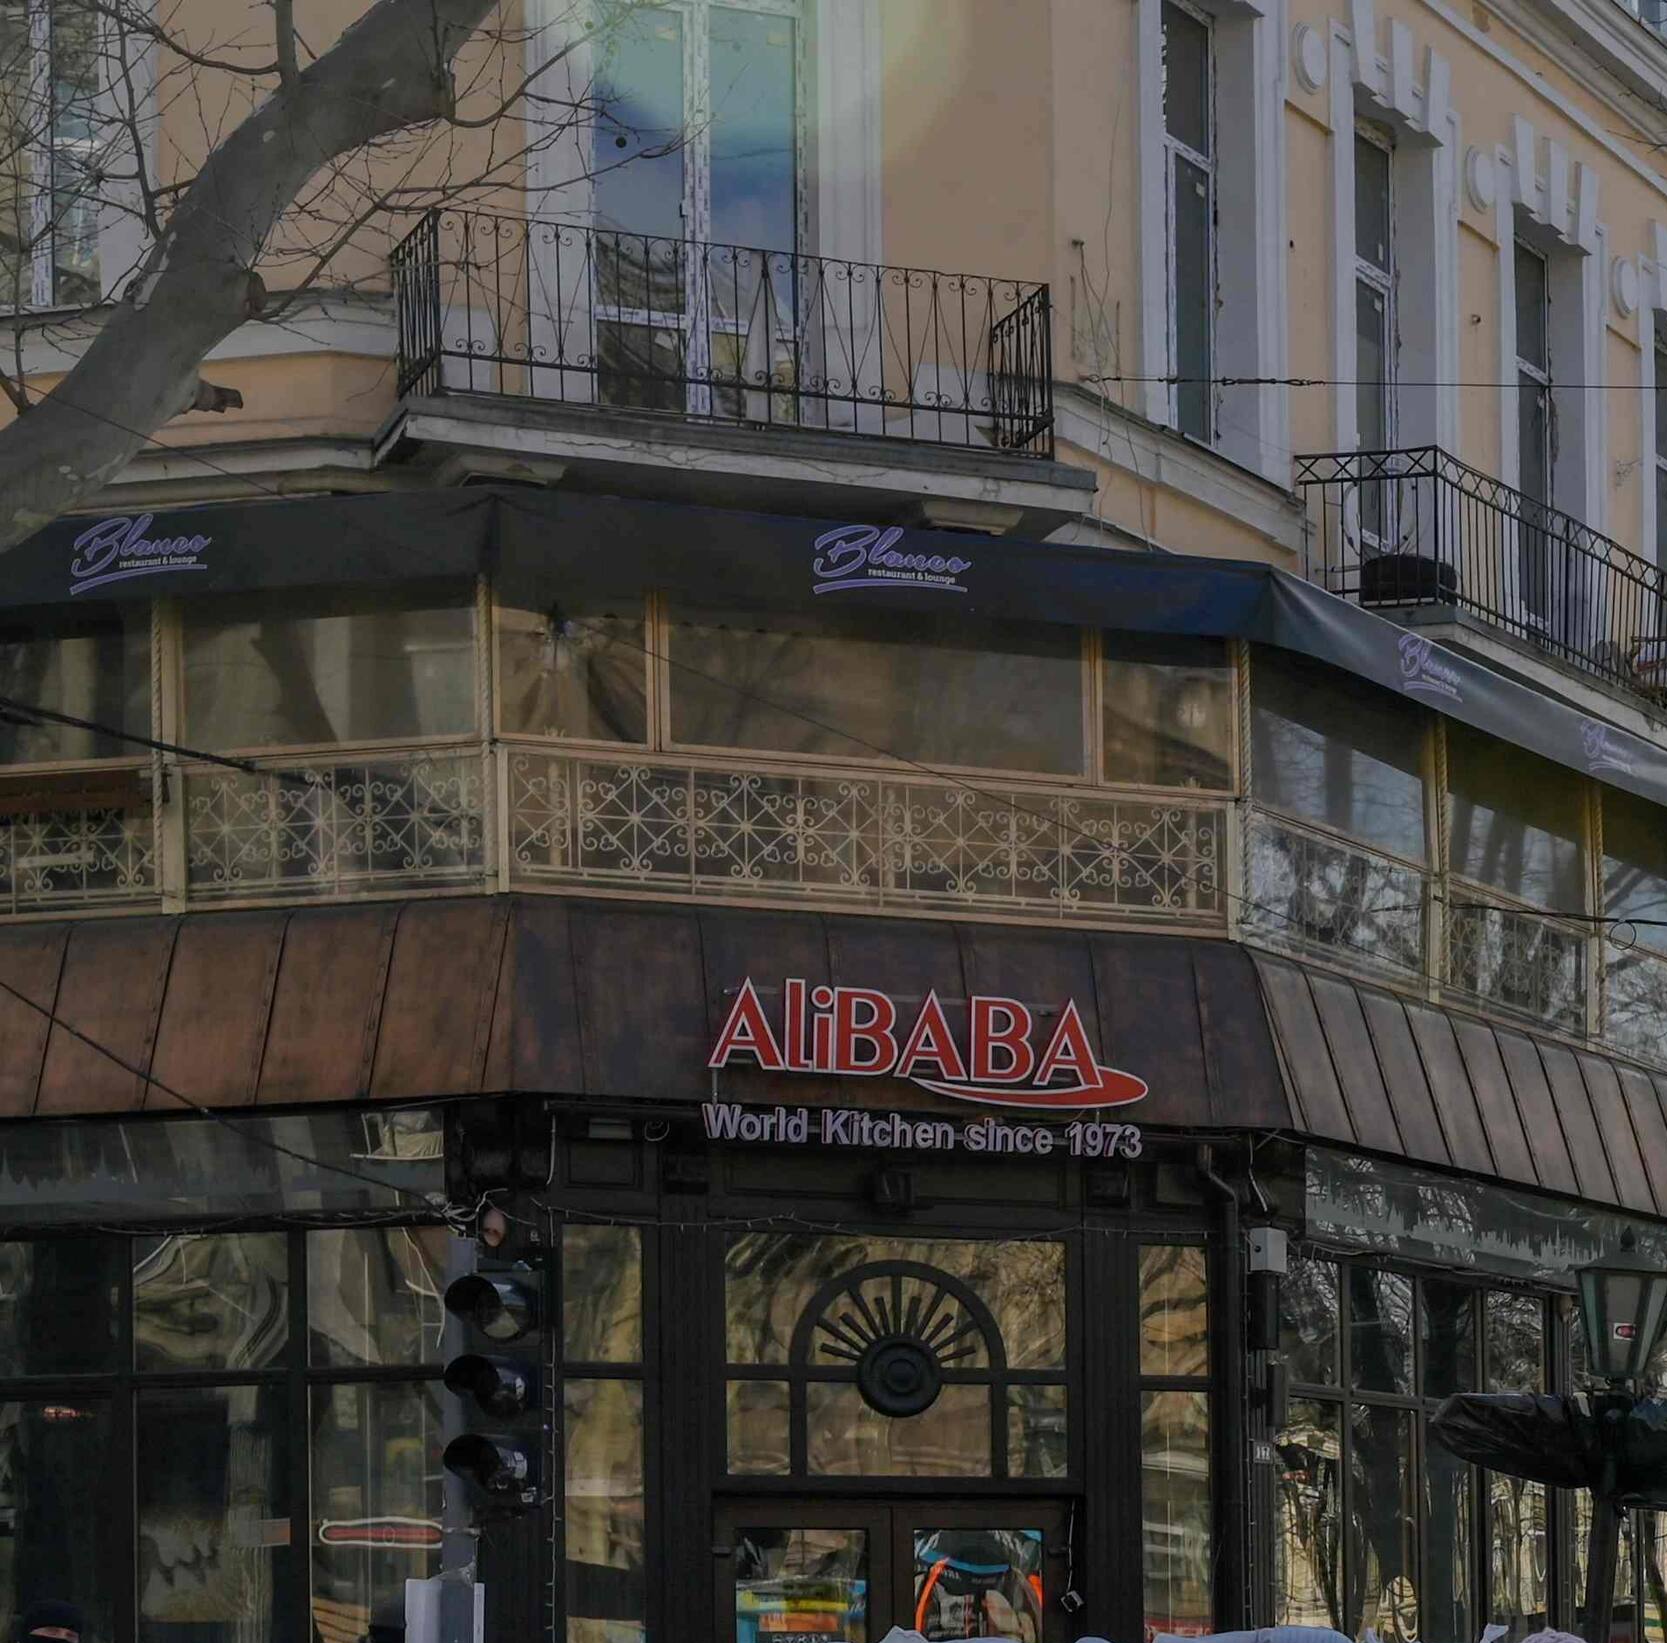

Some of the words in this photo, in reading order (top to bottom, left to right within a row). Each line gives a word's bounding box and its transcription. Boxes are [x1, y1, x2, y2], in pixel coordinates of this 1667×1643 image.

[73, 512, 215, 578] Blanco
[119, 557, 161, 568] restaurant
[169, 555, 198, 564] lounge
[812, 524, 973, 578] Blanco
[867, 568, 916, 580] restaurant
[917, 572, 924, 581] &
[925, 572, 956, 585] lounge
[702, 1103, 810, 1144] World
[821, 1108, 956, 1150] Kitchen
[965, 1117, 1054, 1154] since
[1065, 1122, 1145, 1160] 1973
